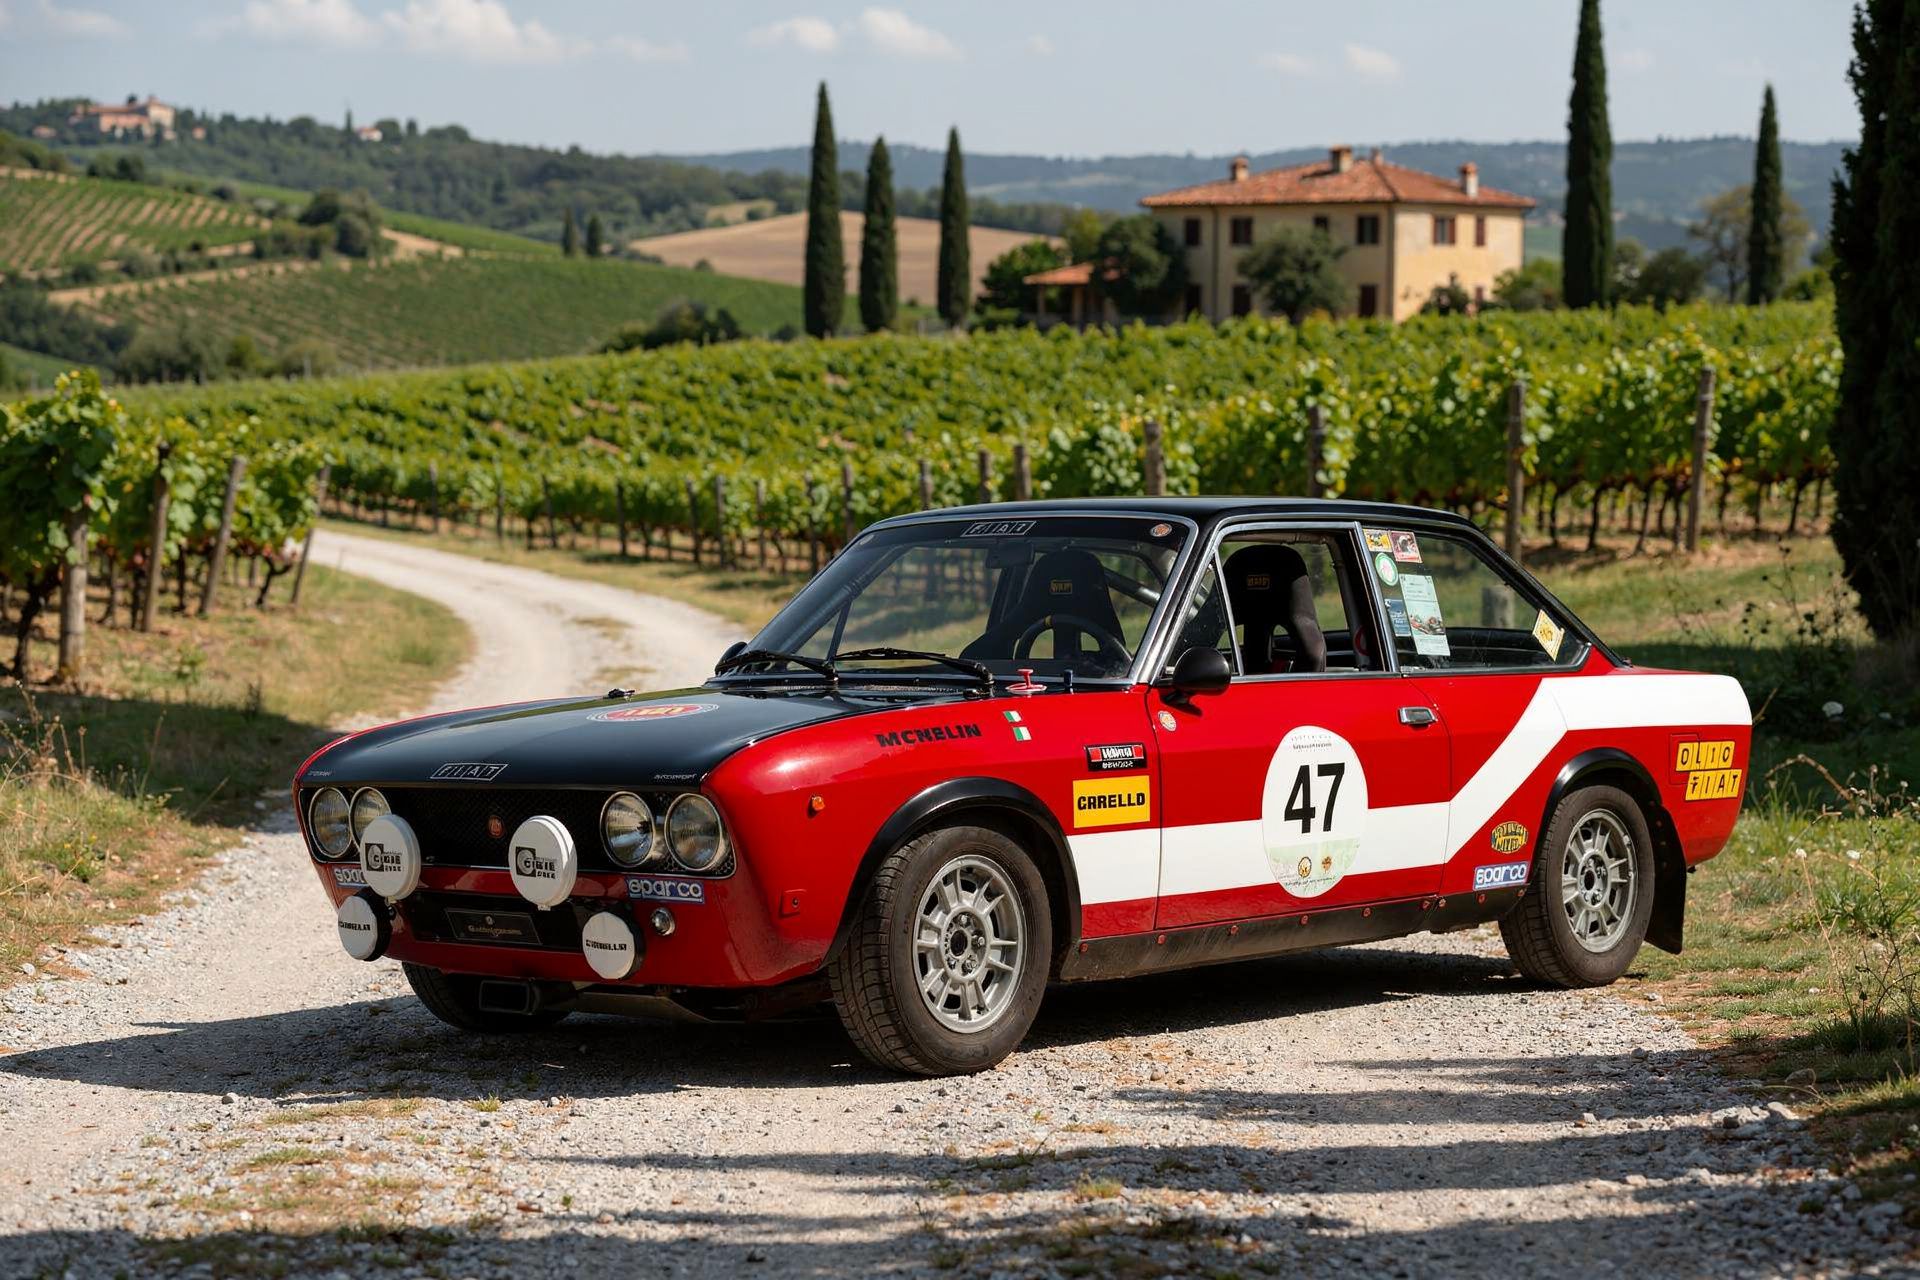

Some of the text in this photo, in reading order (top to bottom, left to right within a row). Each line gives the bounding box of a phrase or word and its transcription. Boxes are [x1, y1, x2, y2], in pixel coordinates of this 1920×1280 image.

[1681, 746, 1730, 766] OLIO
[436, 765, 501, 778] FIAT
[1690, 774, 1738, 795] FIAT
[1284, 762, 1345, 834] 47
[1476, 863, 1527, 885] sparco
[629, 878, 702, 898] sparco
